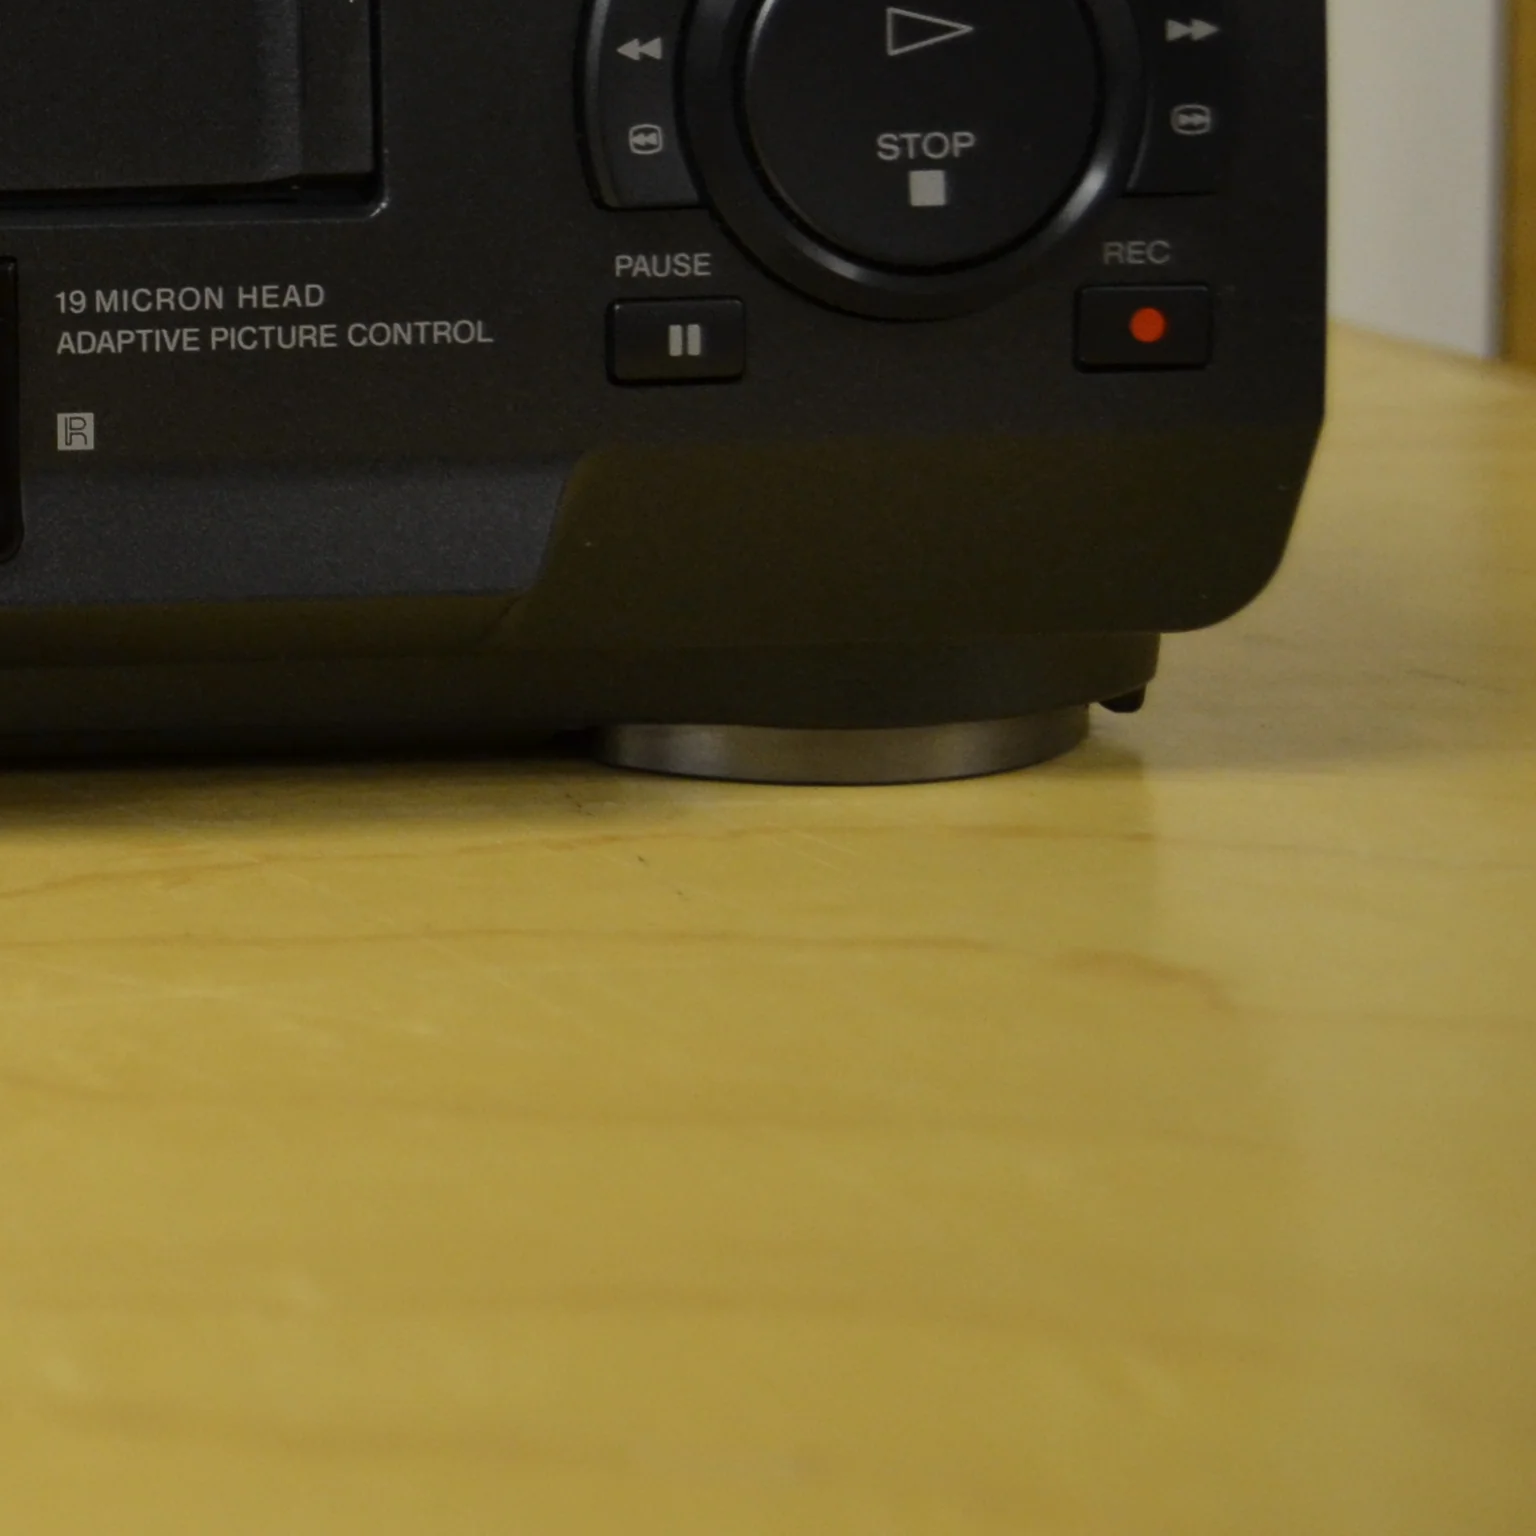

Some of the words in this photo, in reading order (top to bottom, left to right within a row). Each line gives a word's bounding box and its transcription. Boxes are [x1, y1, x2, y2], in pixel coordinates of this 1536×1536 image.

[876, 132, 975, 160] STOP
[614, 253, 712, 278] PAUSE
[1103, 240, 1171, 265] REC
[55, 290, 87, 313] 19
[94, 286, 225, 312] MICRON
[237, 284, 326, 309] HEAD
[56, 328, 201, 355] ADAPTIVE
[211, 324, 338, 351] PICTURE
[347, 320, 494, 347] CONTROL
